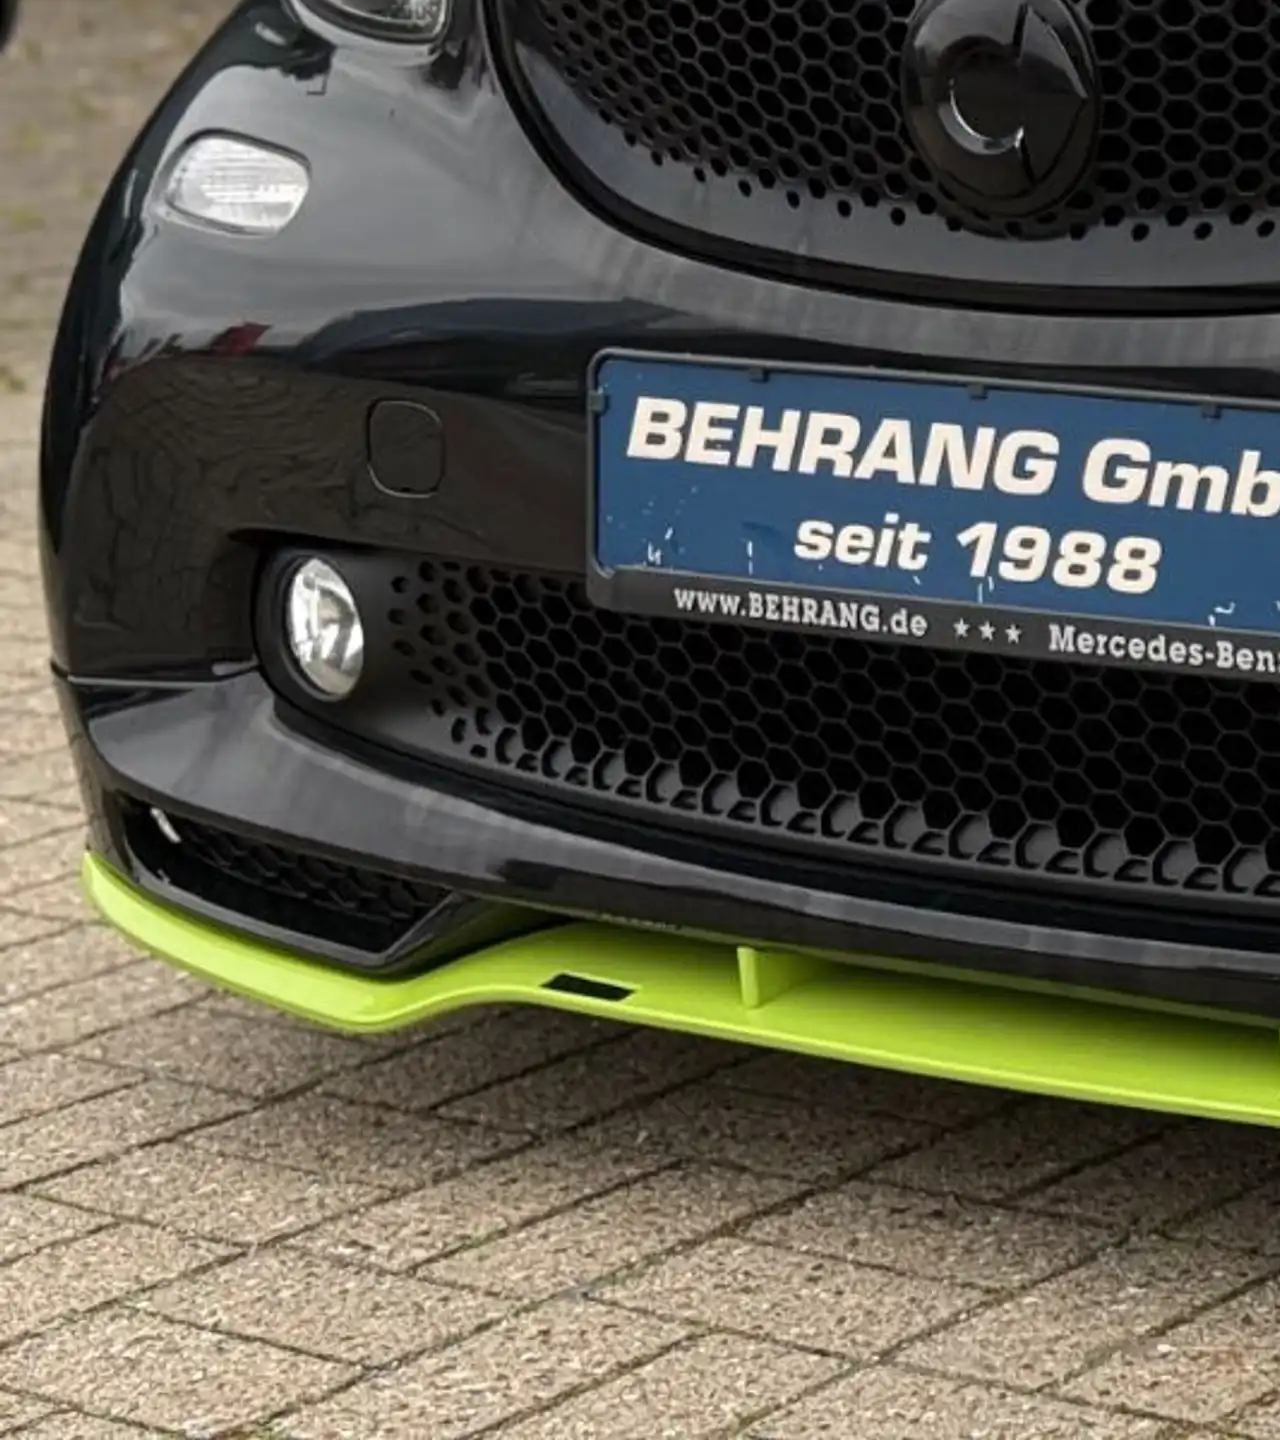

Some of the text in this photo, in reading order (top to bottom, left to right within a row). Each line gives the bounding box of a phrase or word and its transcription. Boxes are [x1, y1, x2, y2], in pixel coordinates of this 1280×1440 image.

[626, 396, 1060, 496] BEHRANG
[793, 513, 1163, 594] seit 1988
[674, 588, 928, 637] www.BEHRANG.de
